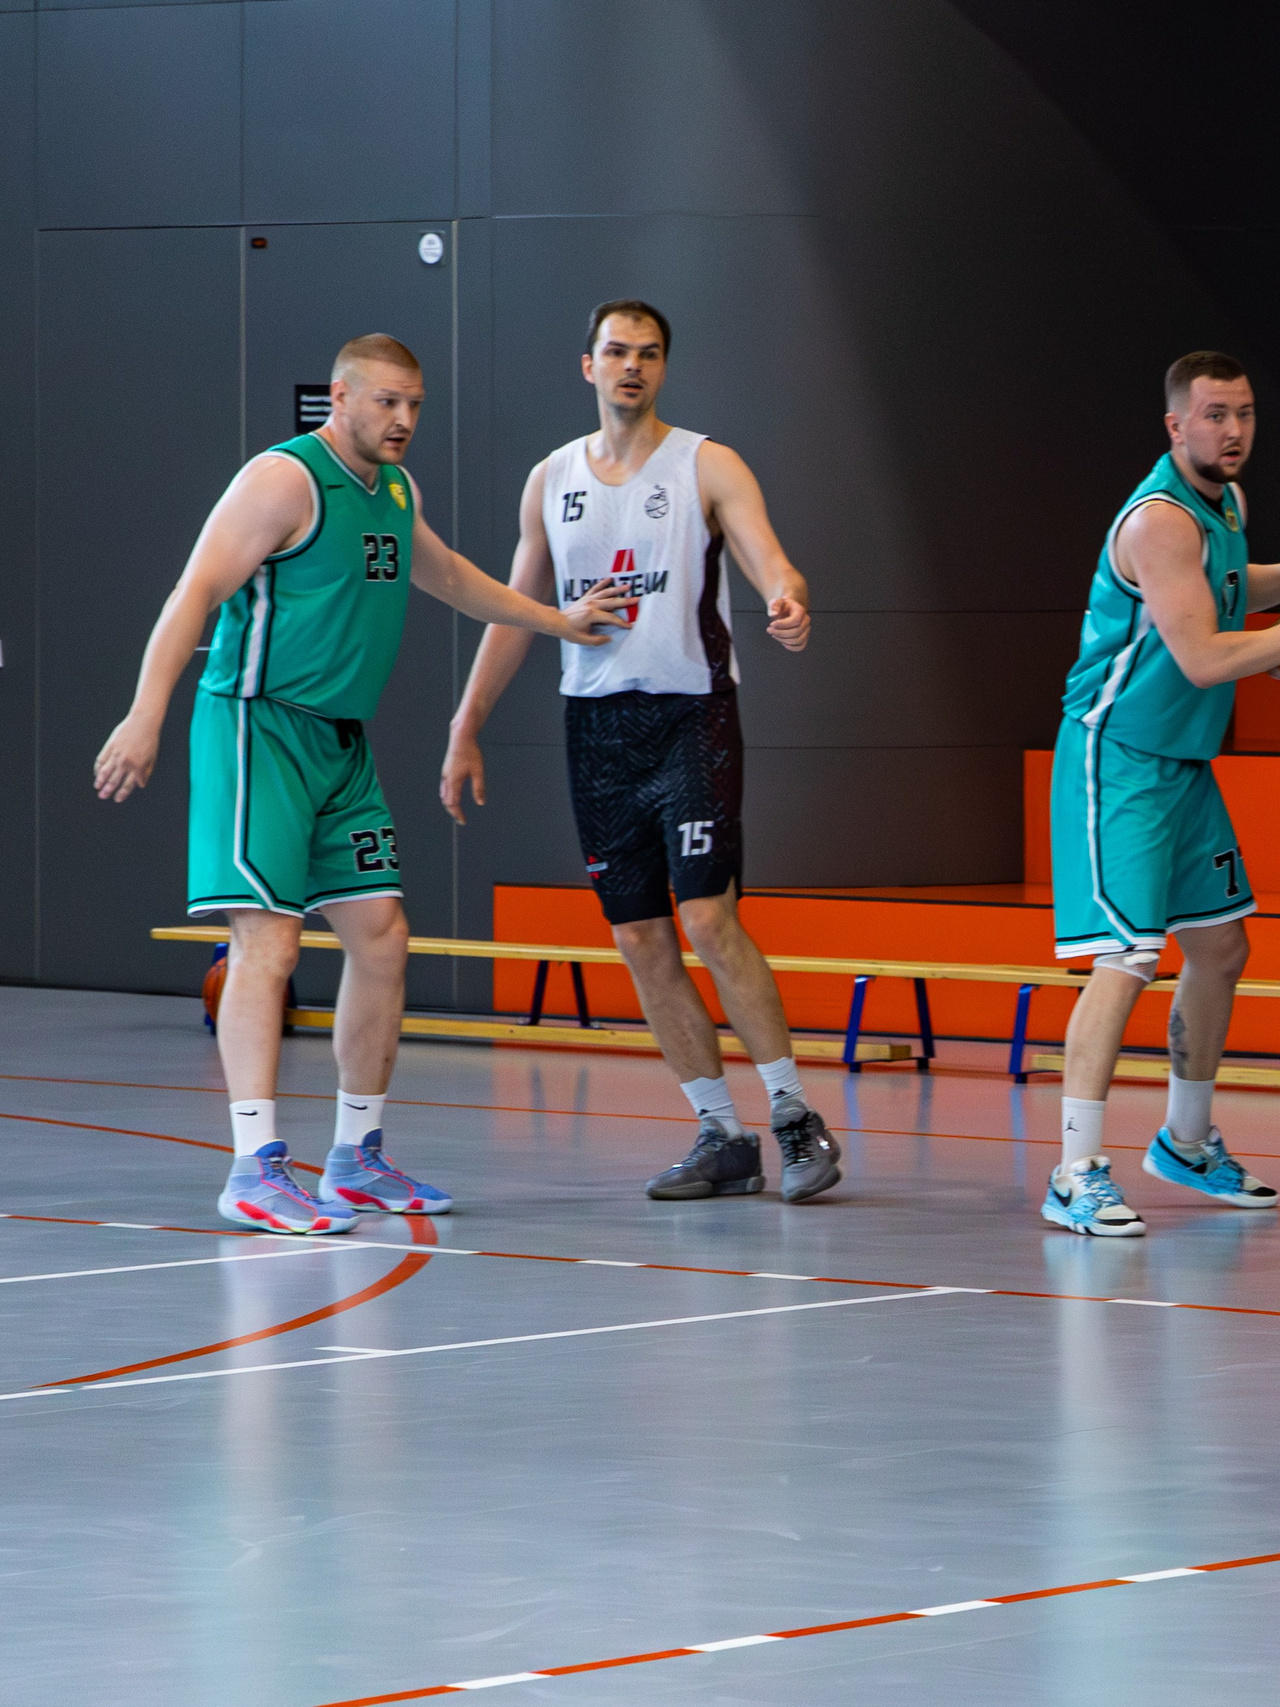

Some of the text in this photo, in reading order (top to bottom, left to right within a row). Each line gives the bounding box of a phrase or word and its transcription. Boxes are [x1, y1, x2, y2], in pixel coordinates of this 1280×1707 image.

[562, 490, 588, 523] 15
[361, 532, 399, 582] 23
[348, 825, 399, 874] 23
[677, 820, 715, 857] 15
[1212, 845, 1243, 898] 7
